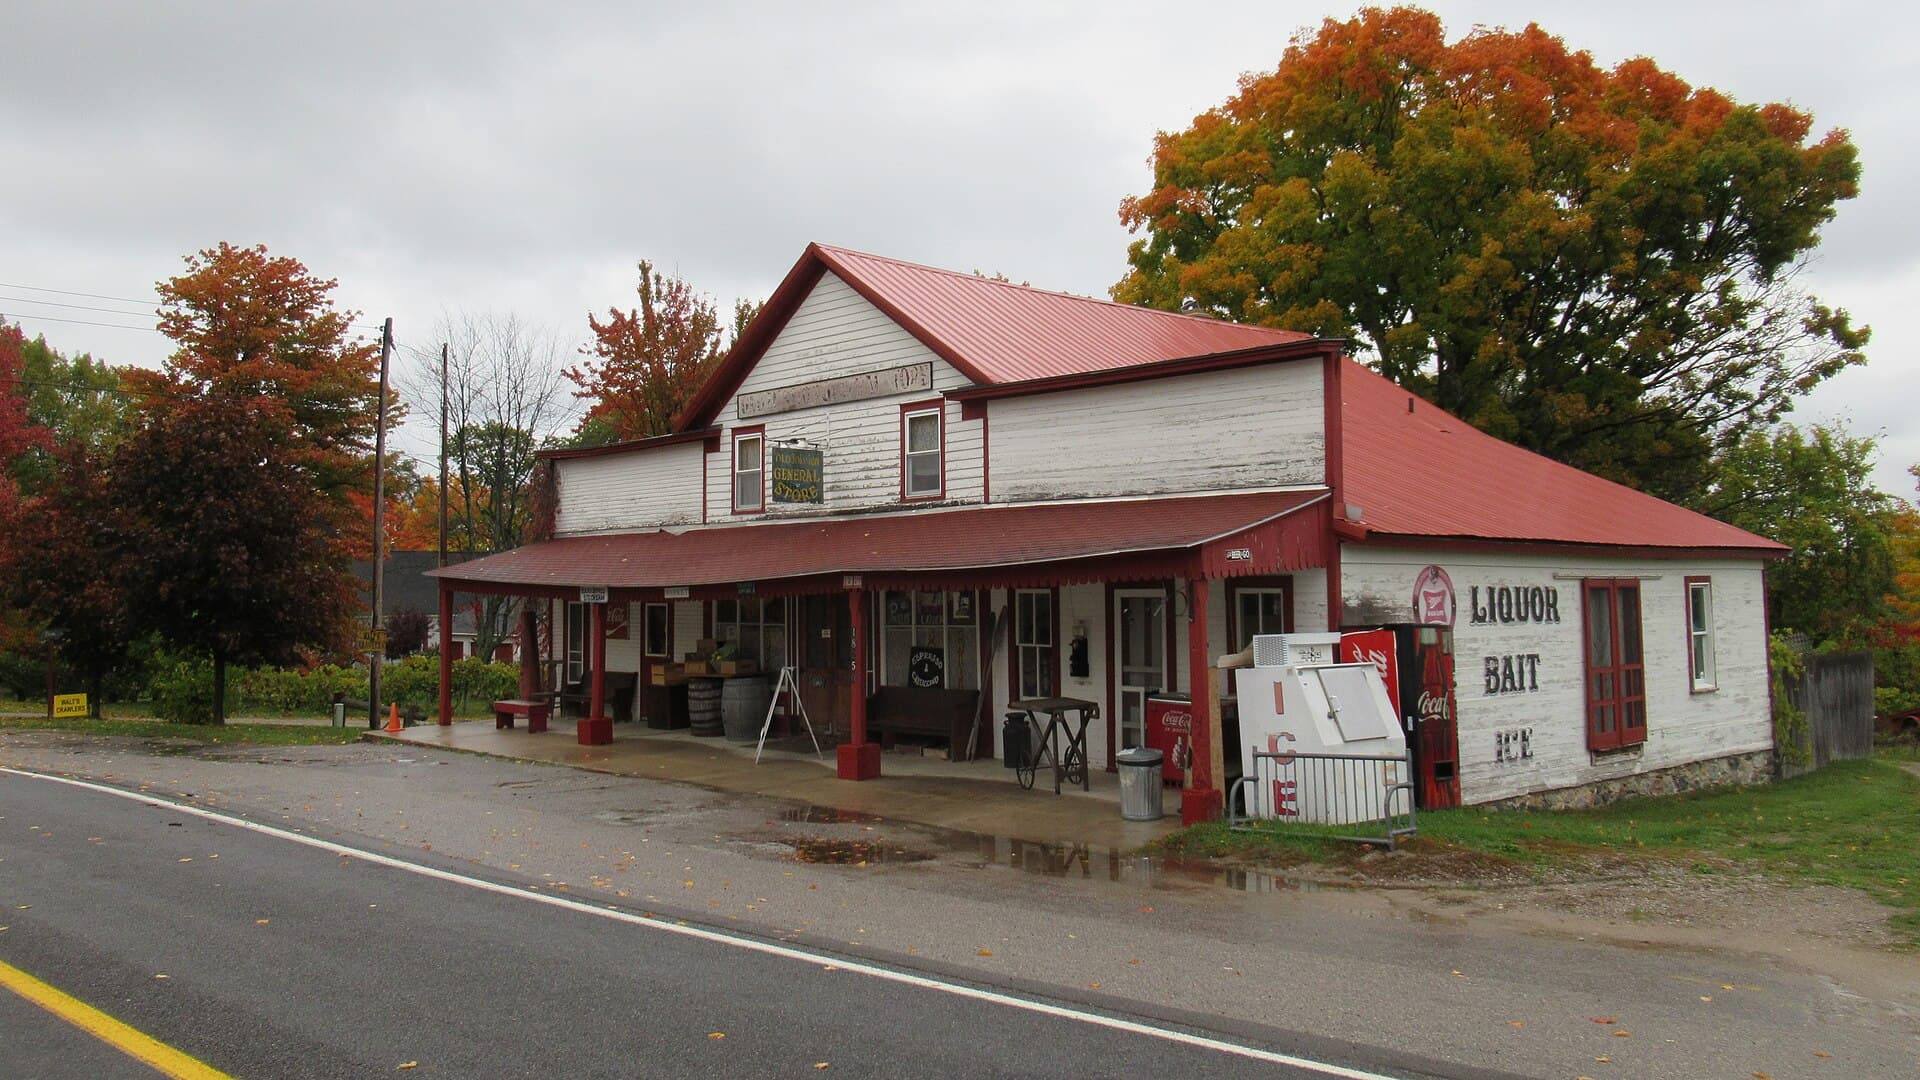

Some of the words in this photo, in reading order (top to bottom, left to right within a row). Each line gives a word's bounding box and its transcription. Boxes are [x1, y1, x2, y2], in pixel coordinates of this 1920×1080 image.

[774, 467, 822, 482] GENERAL
[774, 482, 819, 503] STORE
[1470, 586, 1561, 625] LIQUOR
[1484, 654, 1541, 696] BAIT
[56, 705, 86, 714] CRAWLERS
[1496, 727, 1534, 764] ICE
